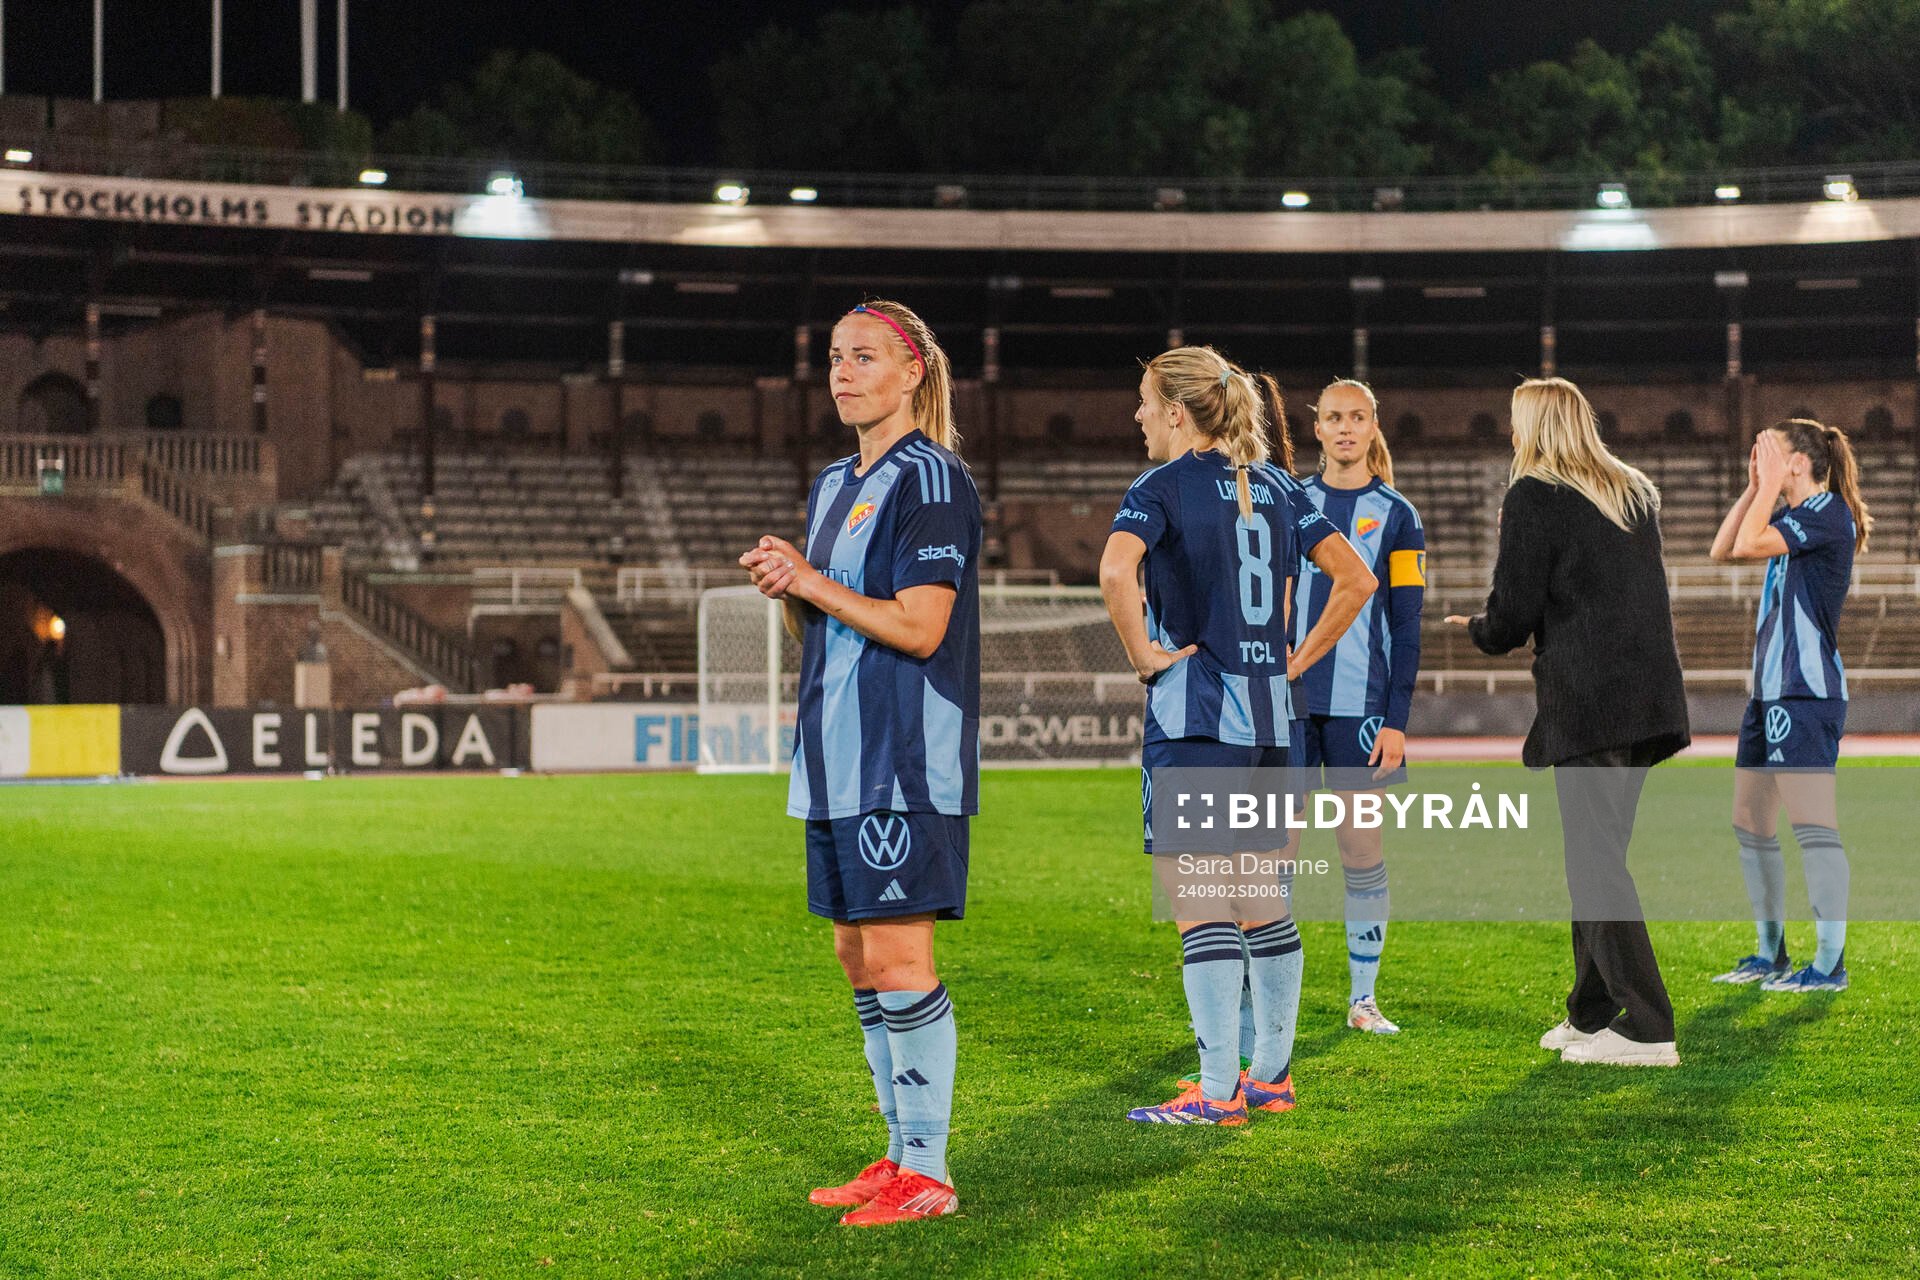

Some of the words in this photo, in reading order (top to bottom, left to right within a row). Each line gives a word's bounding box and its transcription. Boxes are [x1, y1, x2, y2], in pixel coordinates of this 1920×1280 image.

[18, 187, 269, 223] STOCKHOLMS
[297, 201, 455, 229] STADION
[1215, 479, 1274, 505] LASON
[1235, 512, 1273, 625] 8
[1239, 641, 1275, 664] TCL
[252, 713, 495, 767] ELEDA
